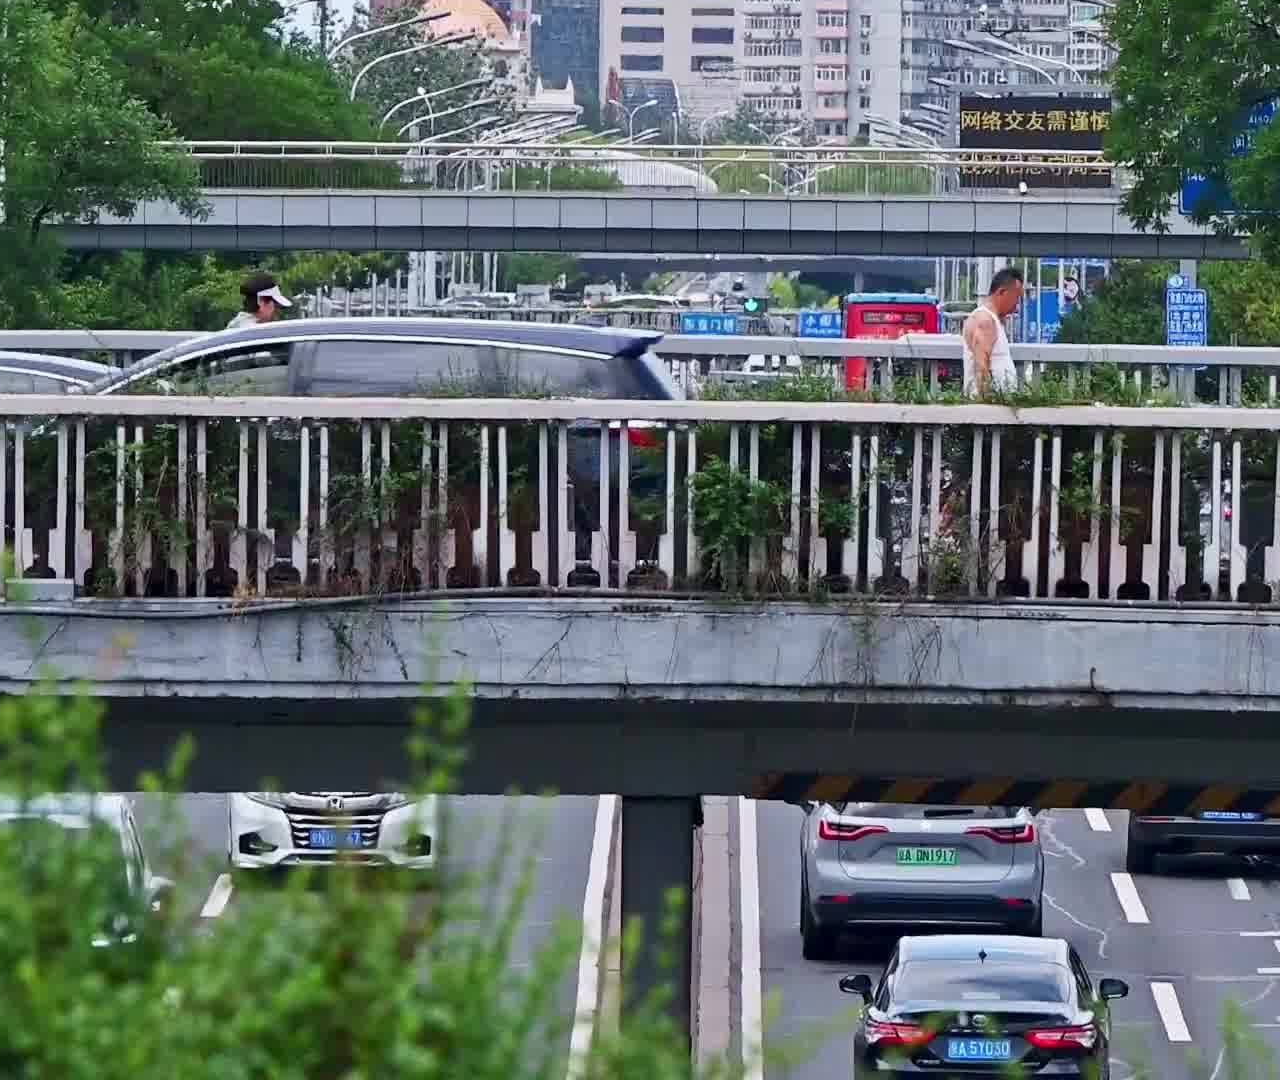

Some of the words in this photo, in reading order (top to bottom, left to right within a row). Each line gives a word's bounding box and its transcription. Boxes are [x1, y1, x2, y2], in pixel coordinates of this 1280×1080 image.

[960, 110, 1111, 132] 网络交友需谨慎
